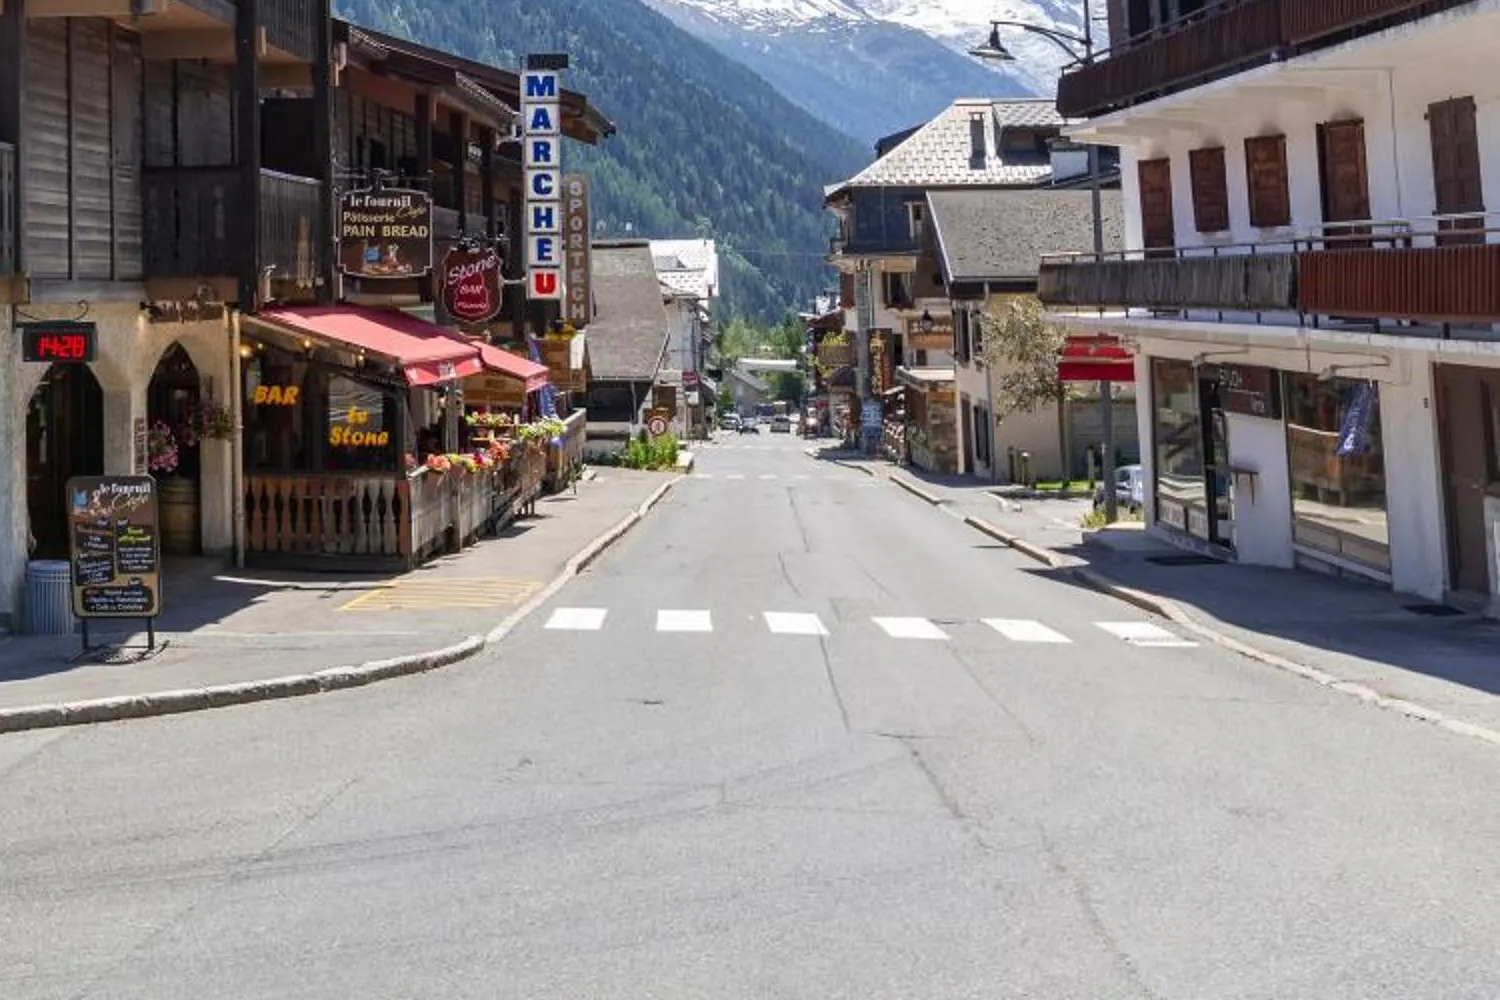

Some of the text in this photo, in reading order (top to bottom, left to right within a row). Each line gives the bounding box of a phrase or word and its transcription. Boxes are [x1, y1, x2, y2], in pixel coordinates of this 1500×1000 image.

[526, 75, 556, 261] MARCHE
[343, 225, 429, 238] PAIN BREAD
[569, 180, 585, 319] SPORTECH
[447, 255, 496, 286] Stone
[253, 384, 300, 405] BAR
[329, 425, 389, 447] Stone
